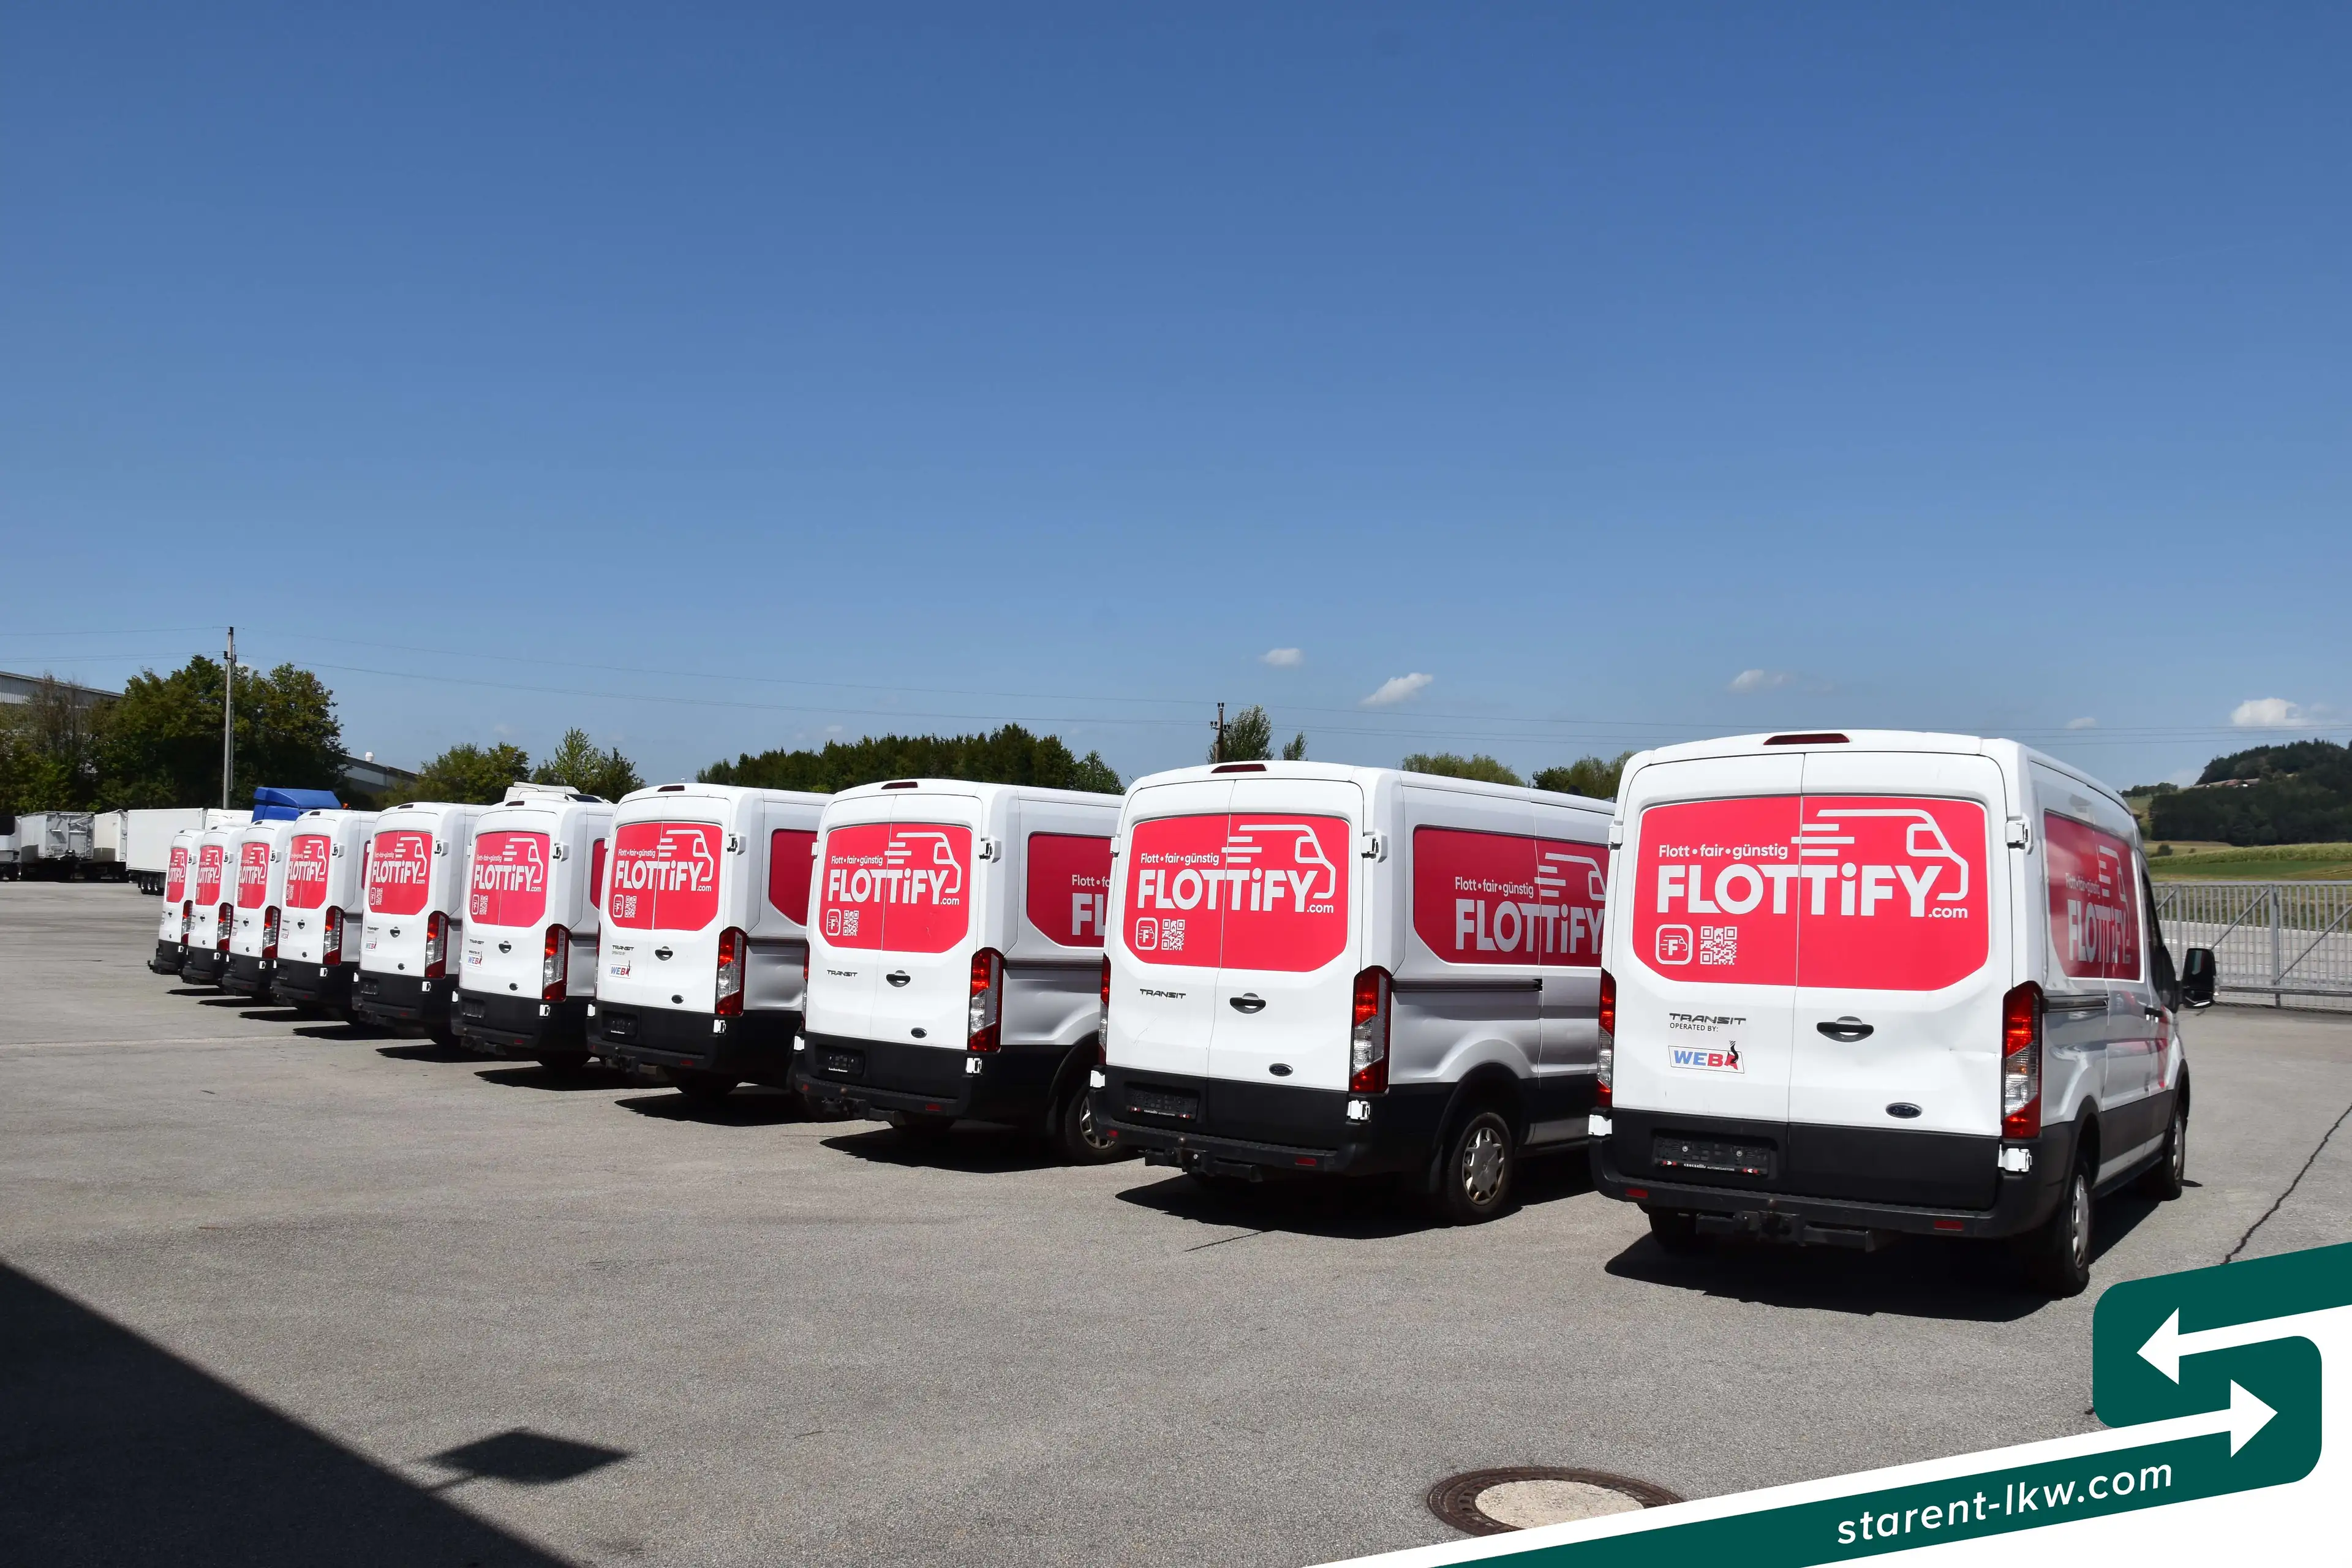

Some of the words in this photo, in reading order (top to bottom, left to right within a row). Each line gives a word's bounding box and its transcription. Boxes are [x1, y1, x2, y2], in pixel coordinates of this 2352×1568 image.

[638, 848, 656, 859] günstig
[831, 855, 843, 864] Flott
[846, 855, 857, 864] fair
[860, 855, 883, 866] günstig
[1140, 853, 1159, 864] Flott
[1165, 852, 1180, 863] fair
[1185, 852, 1219, 866] günstig
[1659, 844, 1690, 858] Flott
[1700, 843, 1724, 857] fair
[1732, 843, 1788, 860] günstig
[372, 860, 421, 884] FLOTTiFY
[473, 864, 537, 892] FLOTTiFY
[614, 859, 704, 892] FLOTTiFY
[1072, 874, 1095, 887] Flott
[827, 867, 949, 905] FLOTTiFY
[940, 897, 960, 905] .com
[1137, 867, 1319, 913] FLOTTiFY
[1306, 903, 1334, 914] .com
[1455, 876, 1477, 891] Flott
[1482, 878, 1498, 893] fair
[1502, 880, 1534, 899] günstig
[1657, 862, 1942, 918] FLOTTiFY
[1928, 906, 1968, 919] .com
[1455, 899, 1605, 954] FLOTTiFY
[1140, 988, 1186, 1000] TRANSIT
[1669, 1012, 1746, 1025] TRANSIT
[1670, 1022, 1705, 1031] OPERATED
[1673, 1049, 1739, 1071] WEBA
